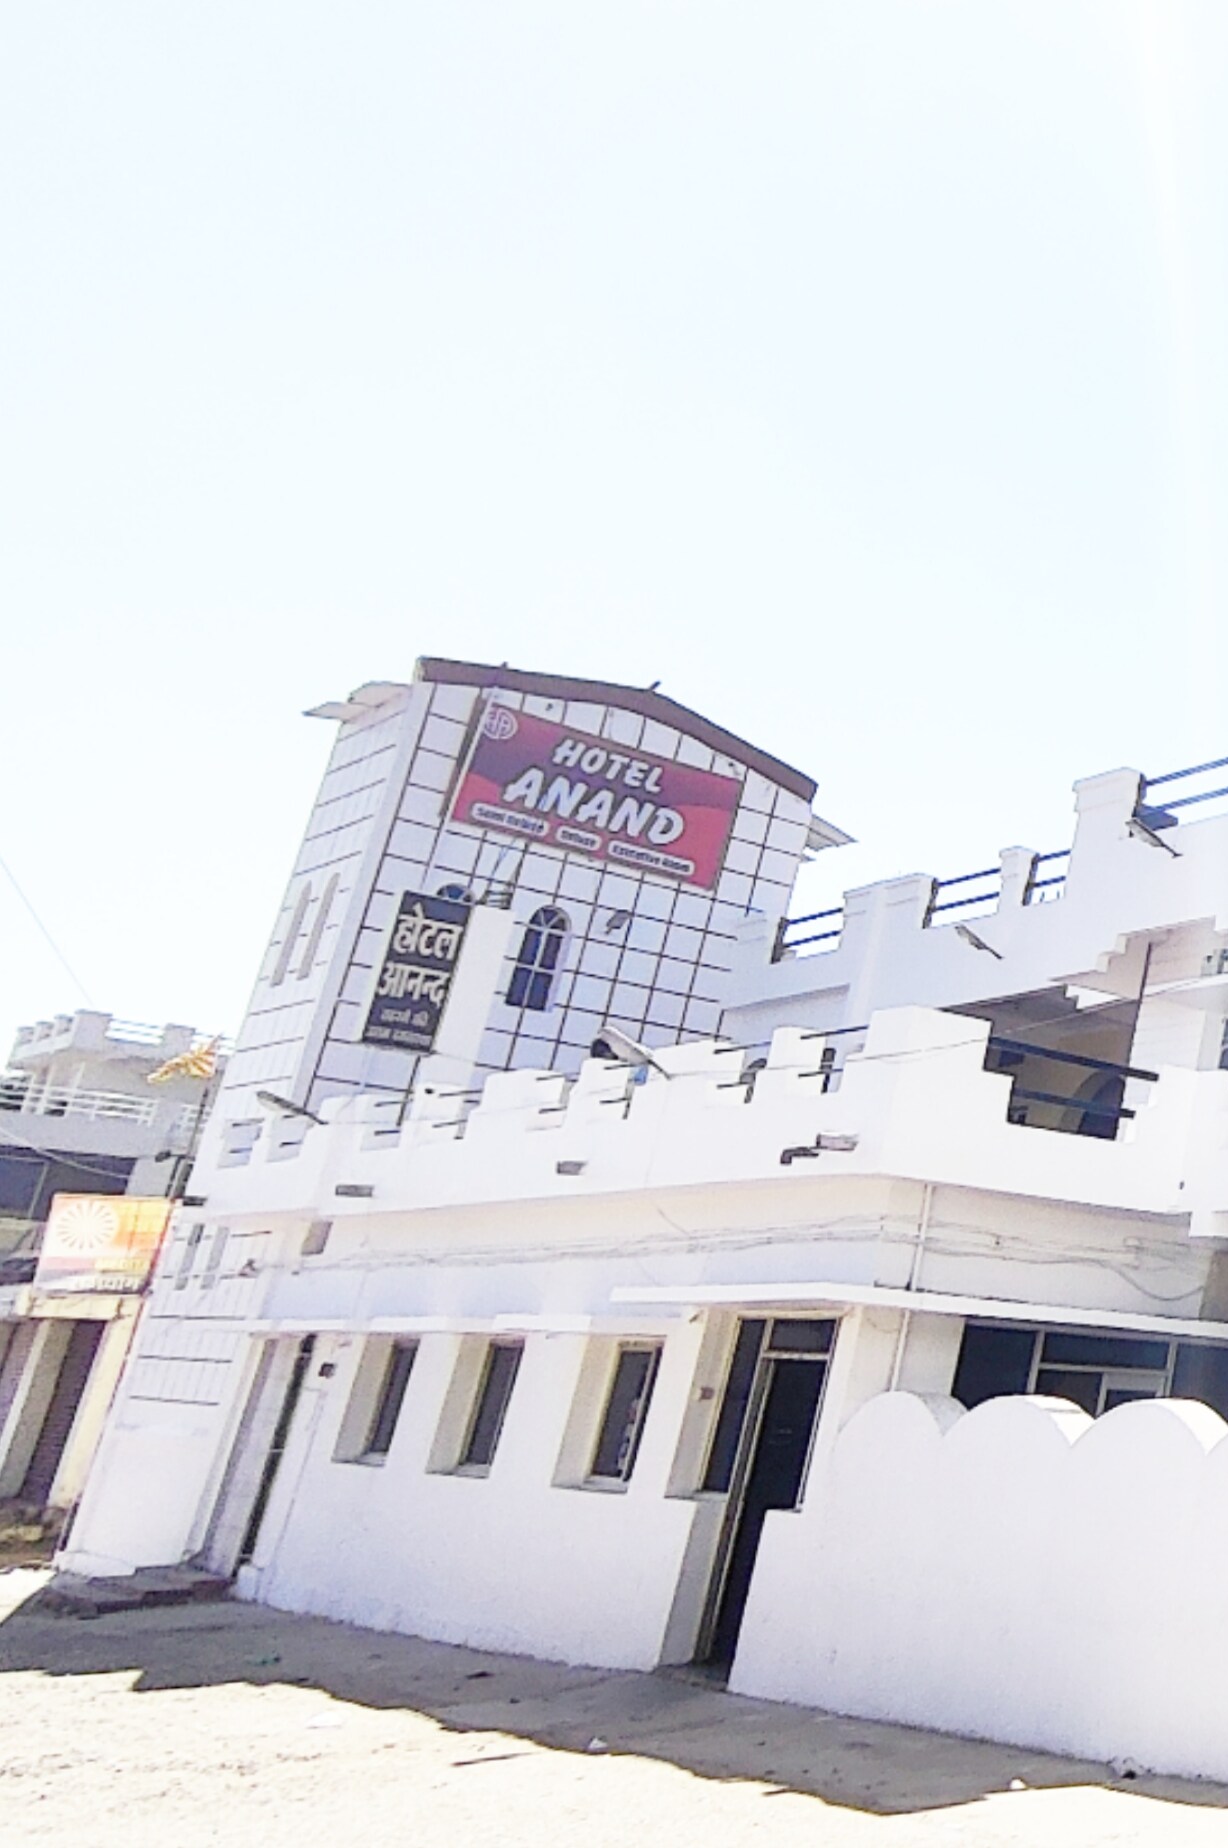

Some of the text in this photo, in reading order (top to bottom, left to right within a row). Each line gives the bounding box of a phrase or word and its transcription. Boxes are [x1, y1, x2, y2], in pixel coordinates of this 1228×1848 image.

[552, 739, 663, 793] HOTEL
[503, 765, 684, 846] ANAND
[393, 901, 464, 960] होटल
[378, 961, 451, 1009] आनन्द
